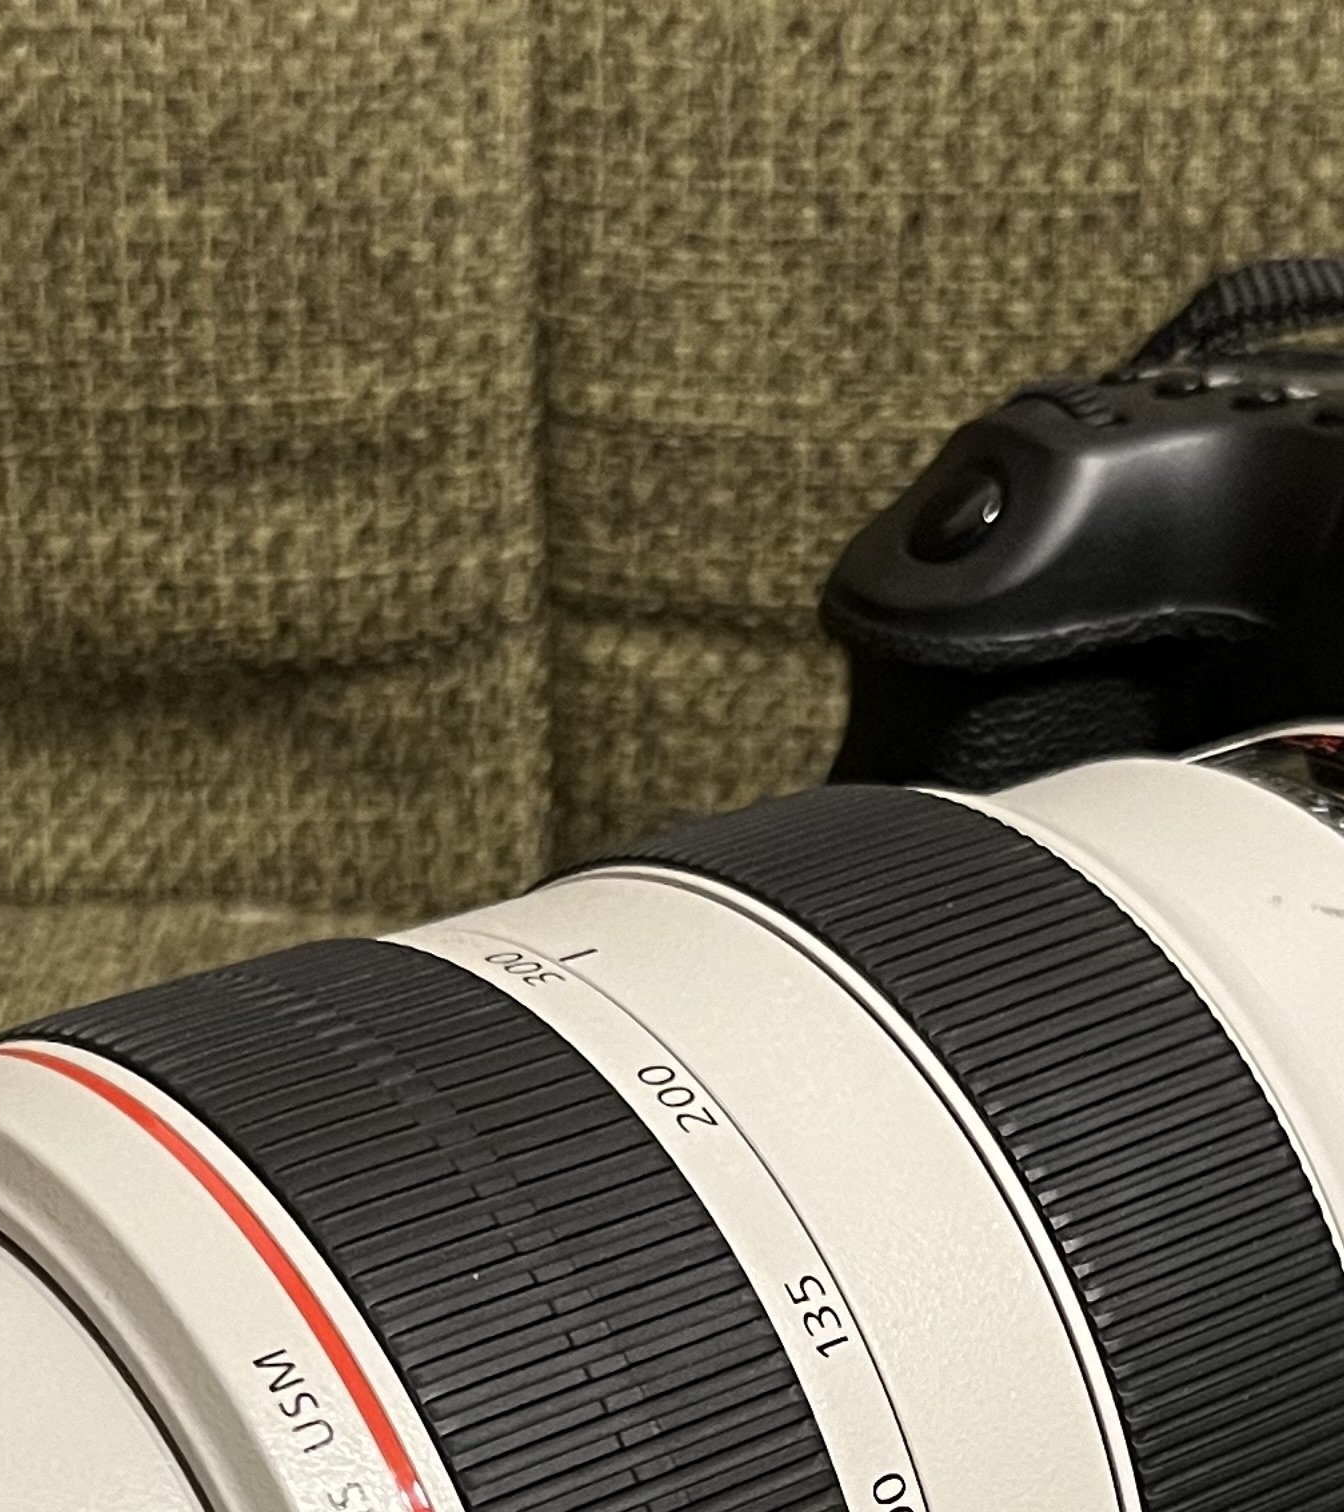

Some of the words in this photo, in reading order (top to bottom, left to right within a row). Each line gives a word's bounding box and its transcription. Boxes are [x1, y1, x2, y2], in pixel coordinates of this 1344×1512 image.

[484, 951, 567, 988] 300
[636, 1064, 719, 1134] 200
[783, 1274, 849, 1359] 135
[252, 1347, 335, 1454] USM
